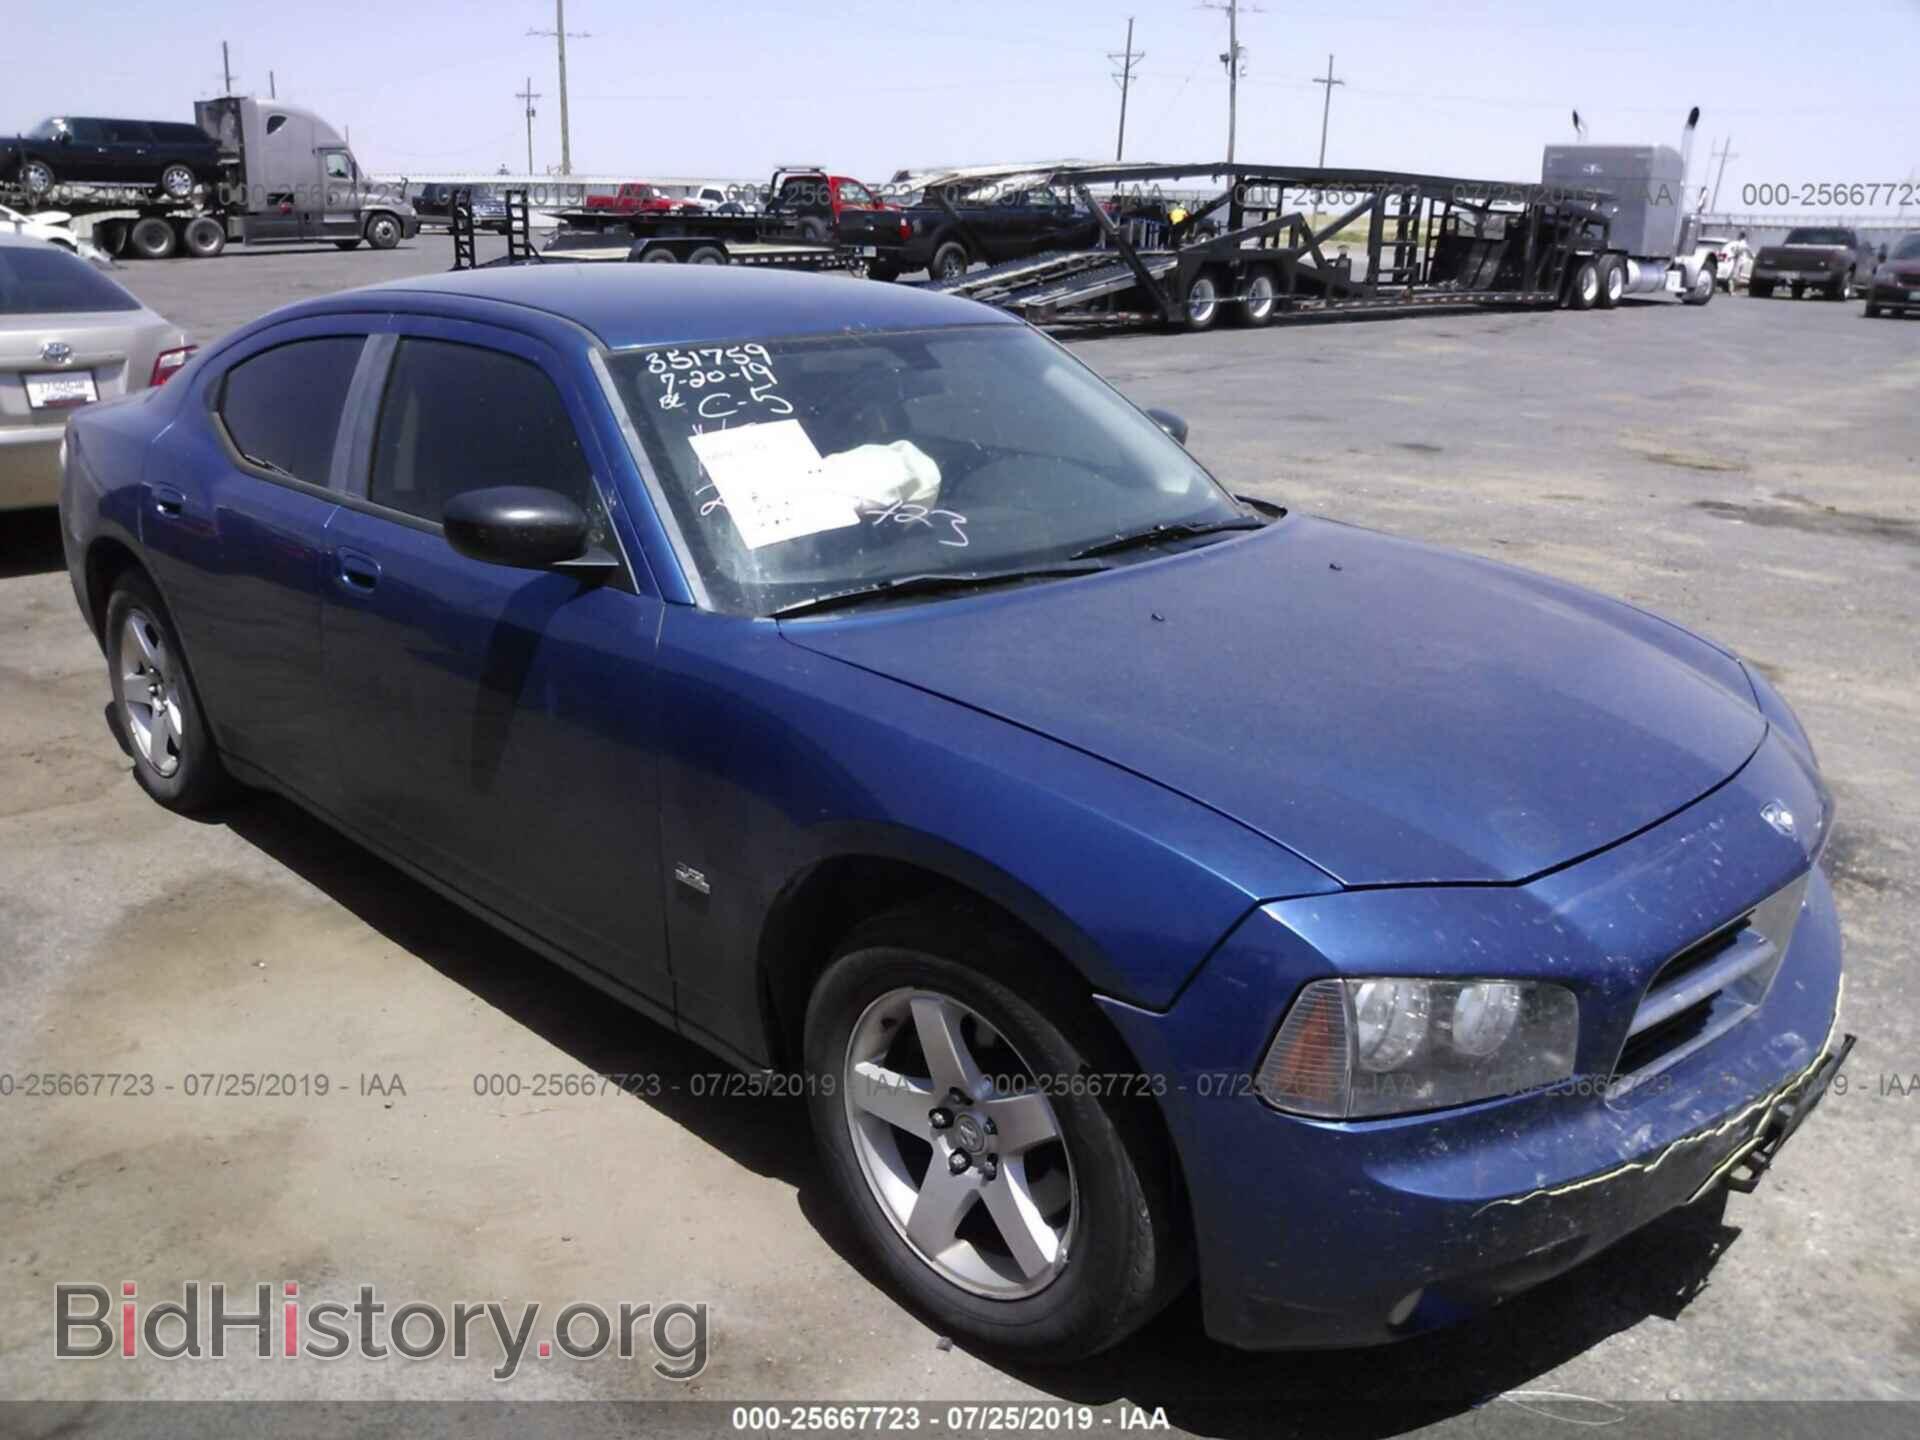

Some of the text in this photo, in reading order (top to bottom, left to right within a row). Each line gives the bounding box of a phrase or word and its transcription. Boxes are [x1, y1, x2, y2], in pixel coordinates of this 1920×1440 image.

[646, 343, 773, 373] 351759
[660, 362, 778, 396] 7-20-19
[698, 384, 794, 418] C-5
